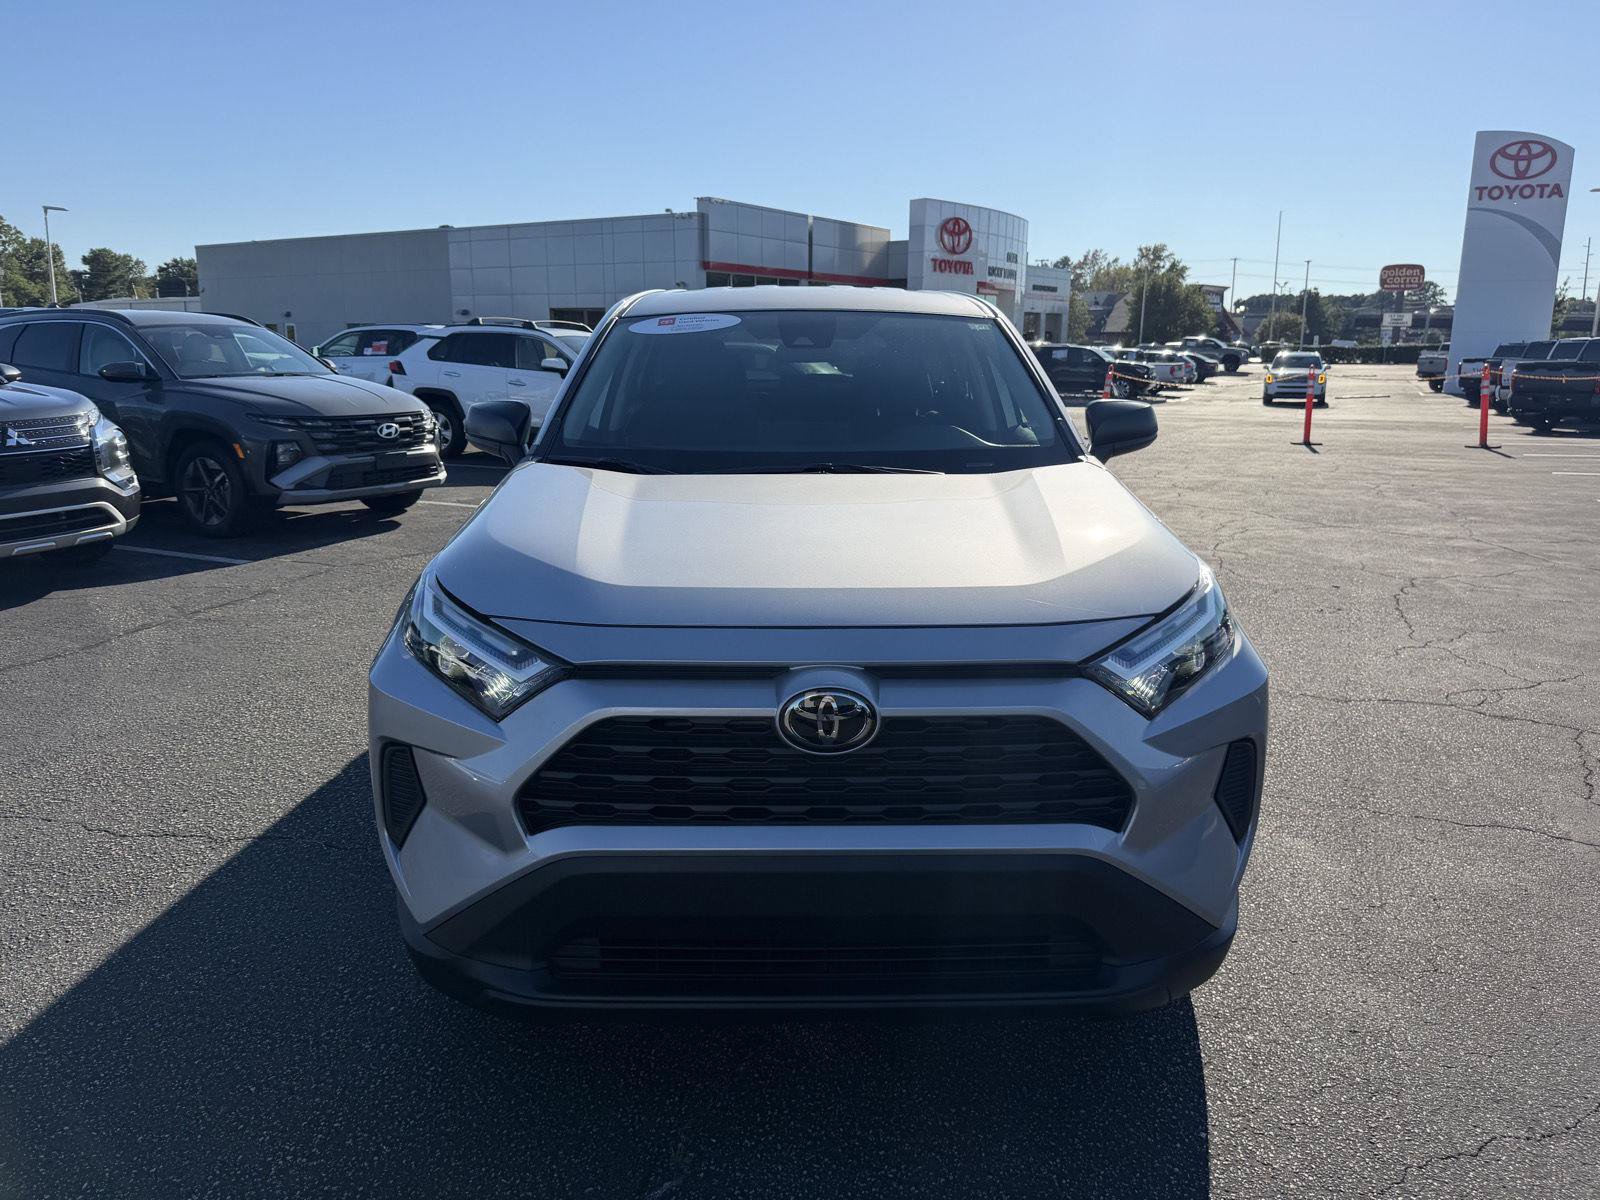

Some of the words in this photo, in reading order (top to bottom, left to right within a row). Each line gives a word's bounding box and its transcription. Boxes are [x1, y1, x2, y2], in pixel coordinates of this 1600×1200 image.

[1475, 183, 1563, 201] TOYOTA
[931, 258, 974, 275] TOYOTA
[1381, 268, 1421, 279] golden
[1386, 275, 1423, 284] corral
